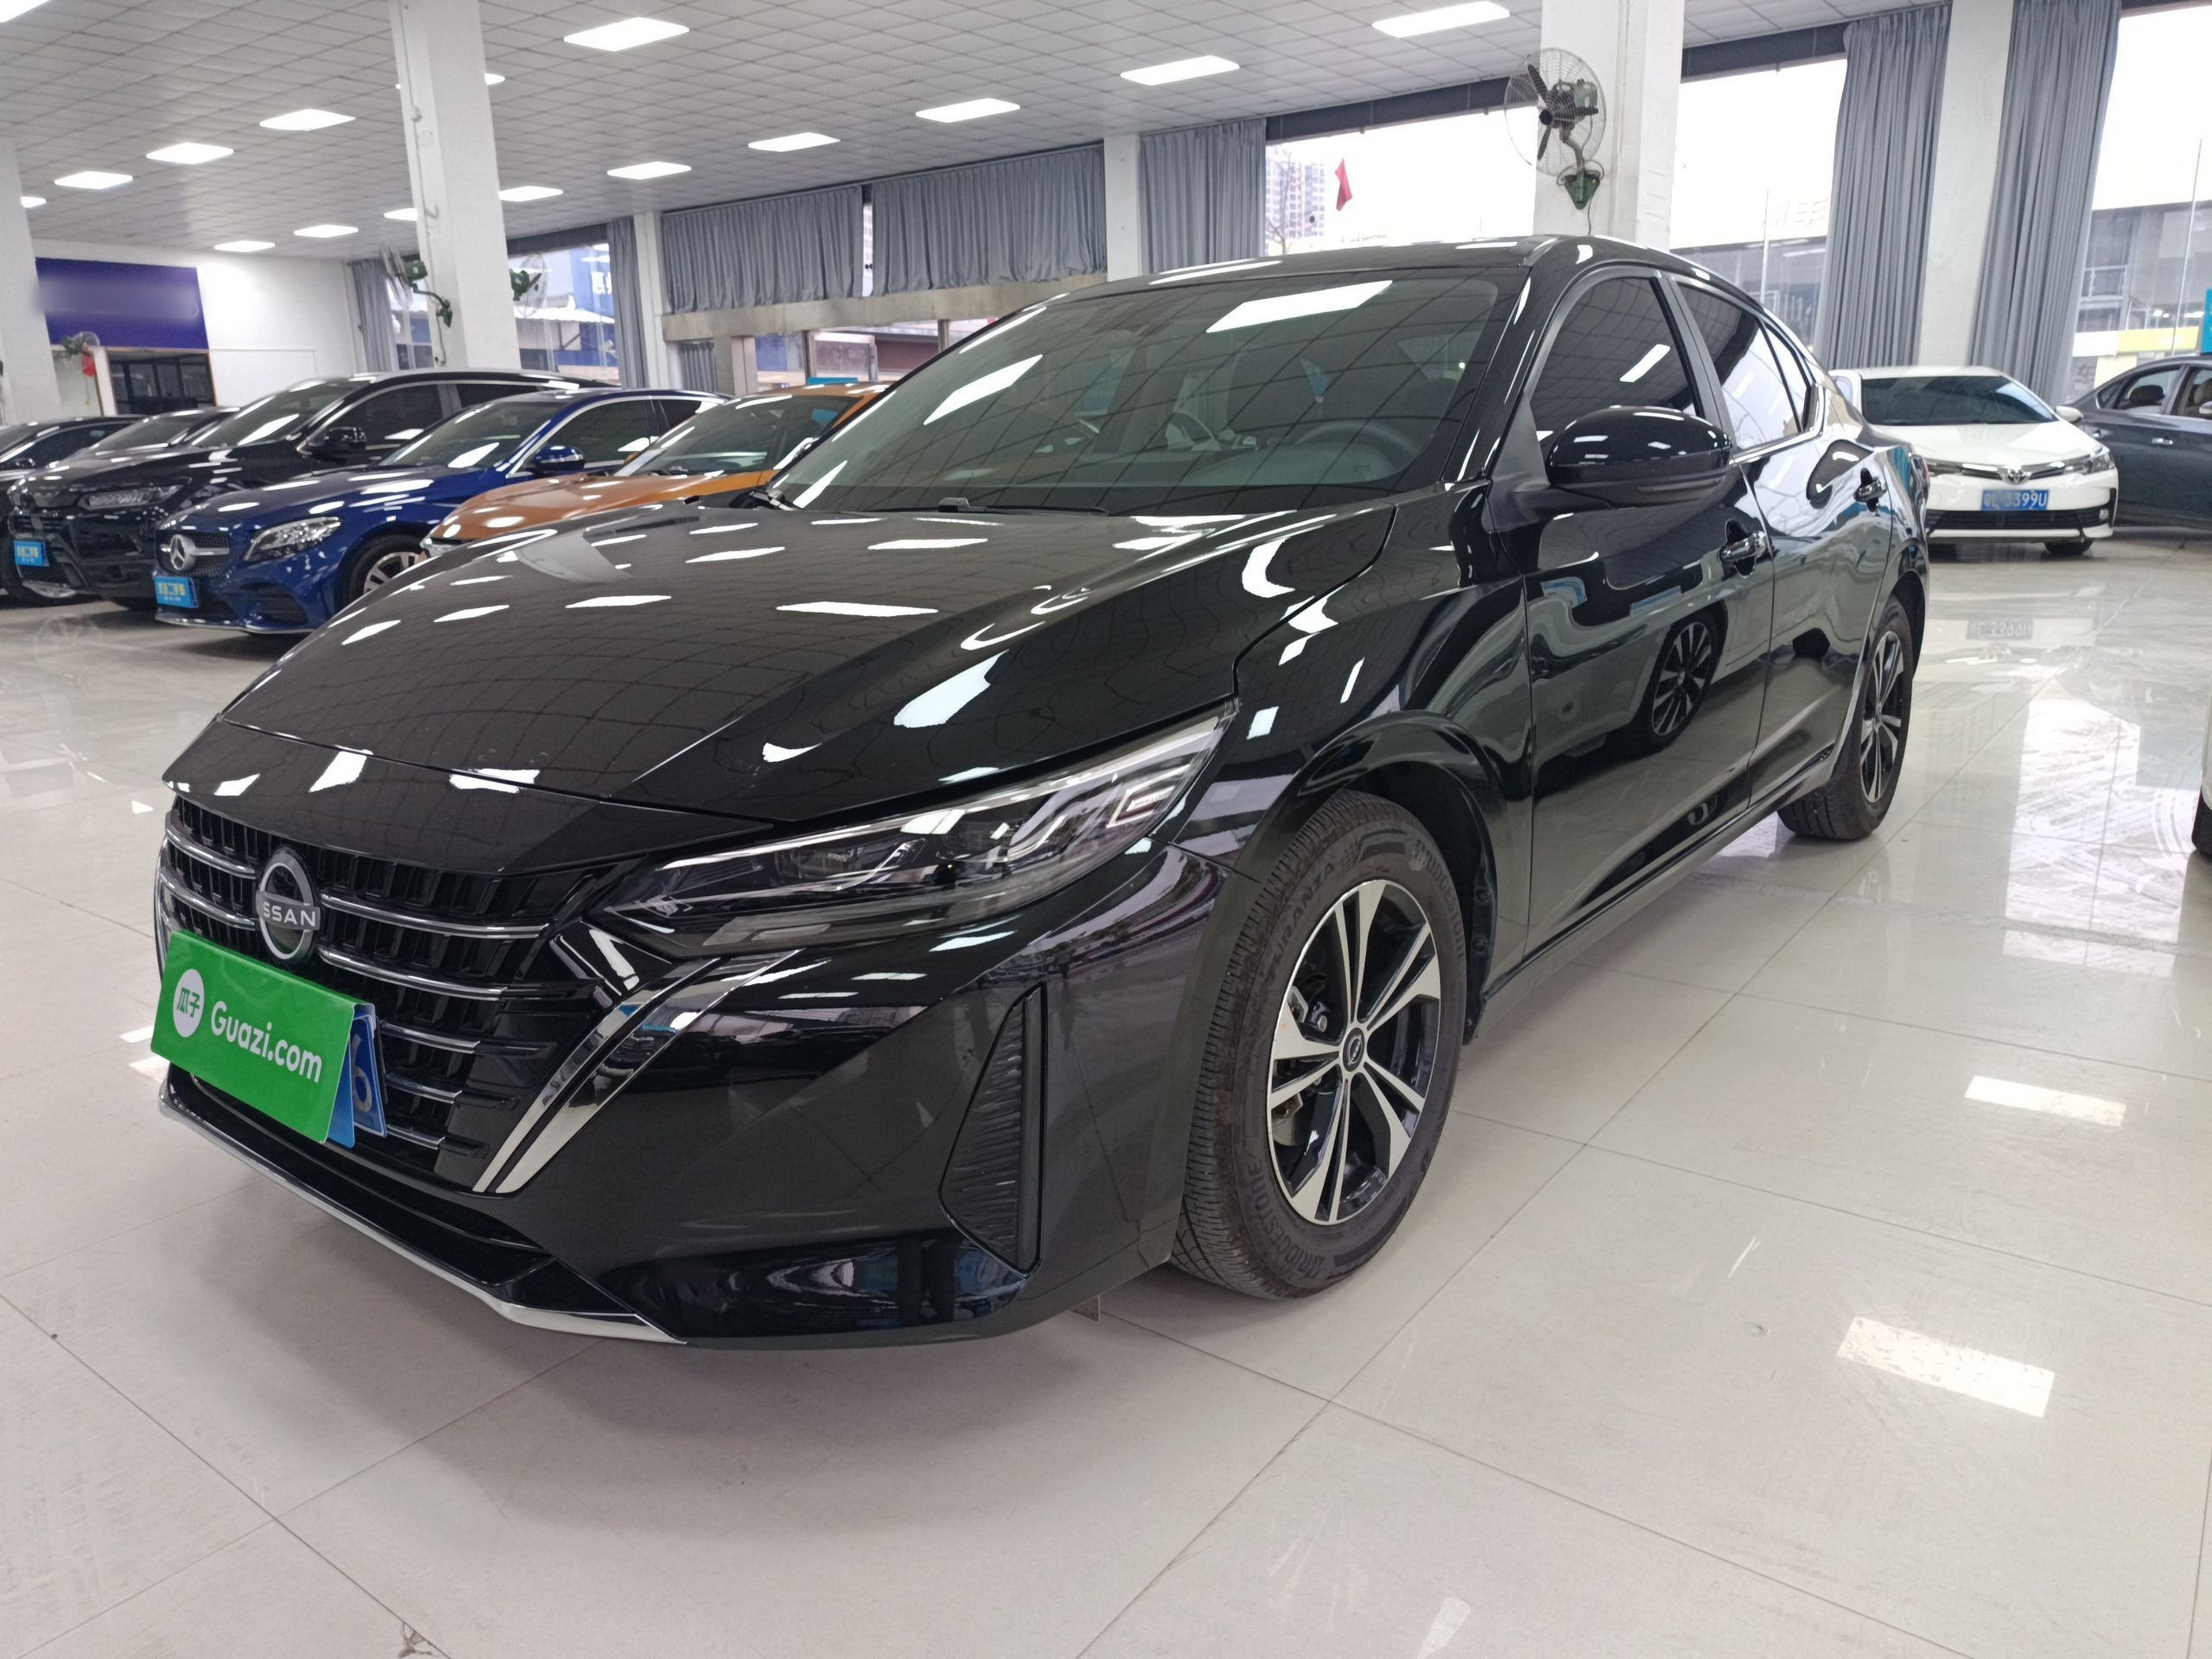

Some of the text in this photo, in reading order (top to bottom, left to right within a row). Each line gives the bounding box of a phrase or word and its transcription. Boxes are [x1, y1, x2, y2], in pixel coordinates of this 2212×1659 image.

[262, 901, 316, 927] SSAN
[176, 987, 200, 1018] 瓜子
[211, 1001, 322, 1083] Guazi.com
